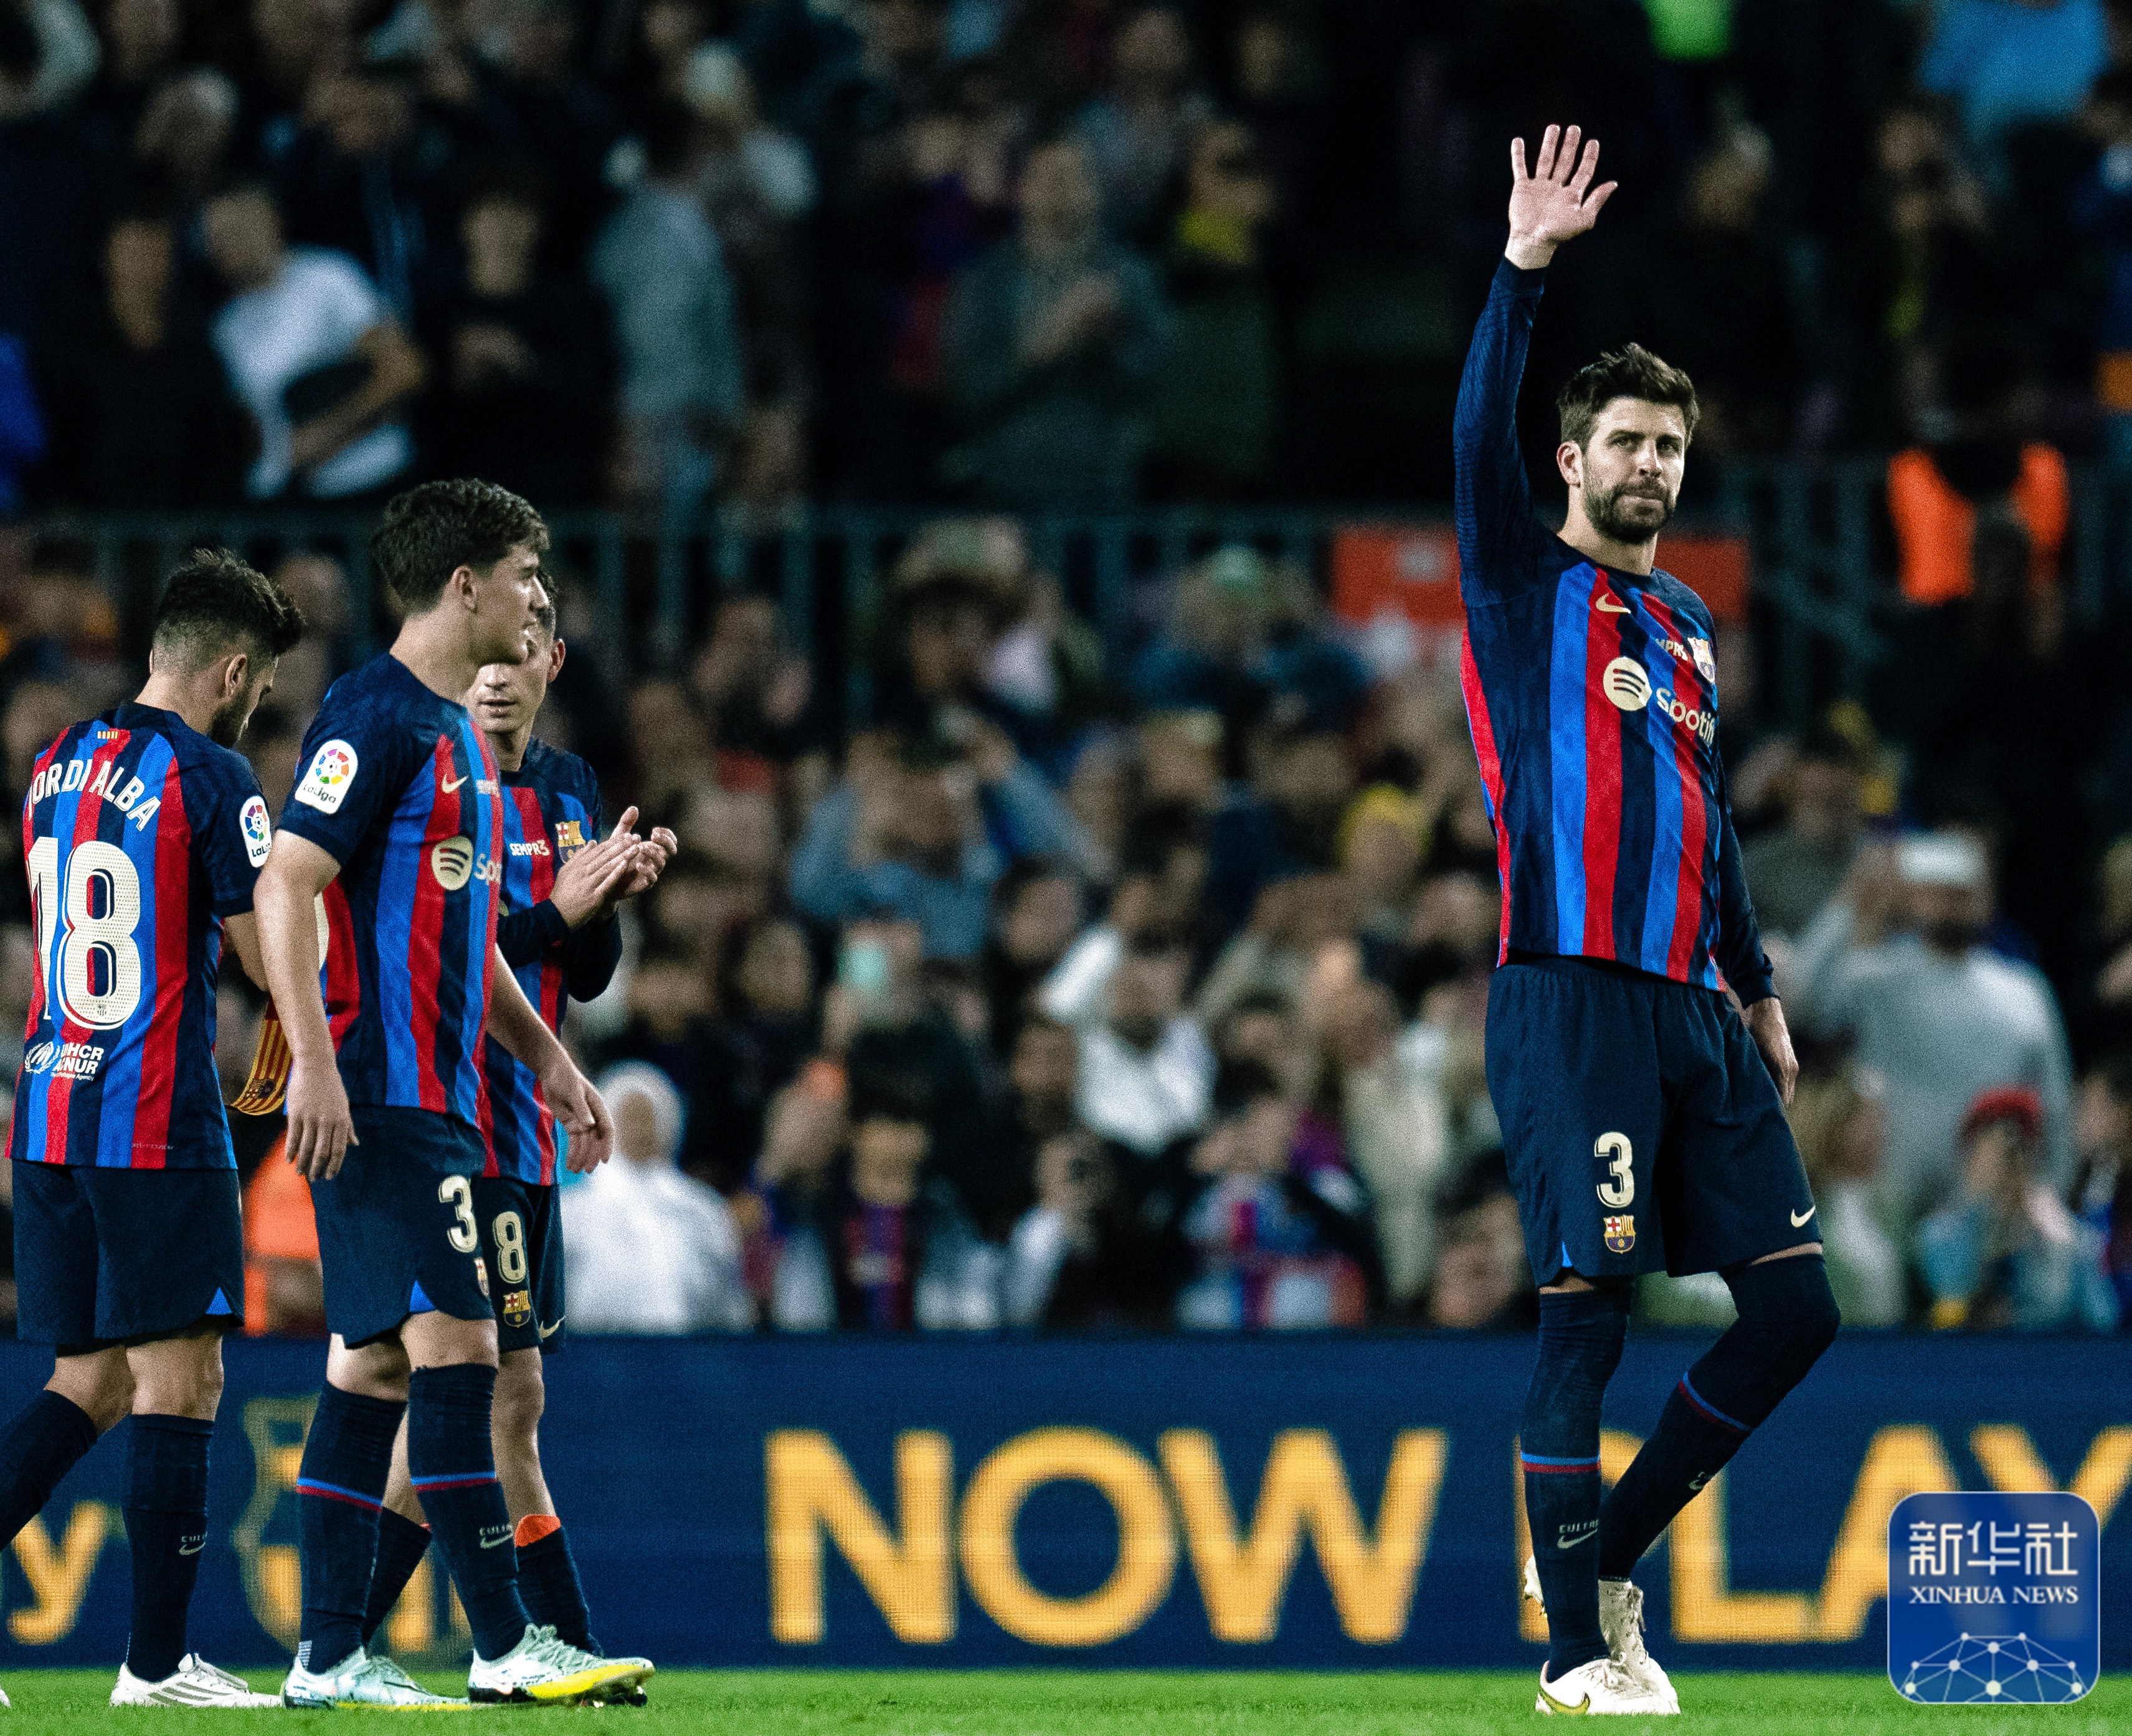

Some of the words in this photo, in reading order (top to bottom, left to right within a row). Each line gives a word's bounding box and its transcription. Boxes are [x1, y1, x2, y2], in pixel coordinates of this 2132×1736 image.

[88, 760, 161, 832] ALBA
[509, 839, 550, 857] SEMPR3
[26, 836, 141, 1030] 18
[1594, 1131, 1635, 1208] 3
[438, 1174, 478, 1253] 3
[493, 1211, 527, 1284] 8
[765, 1426, 1447, 1646] NOW
